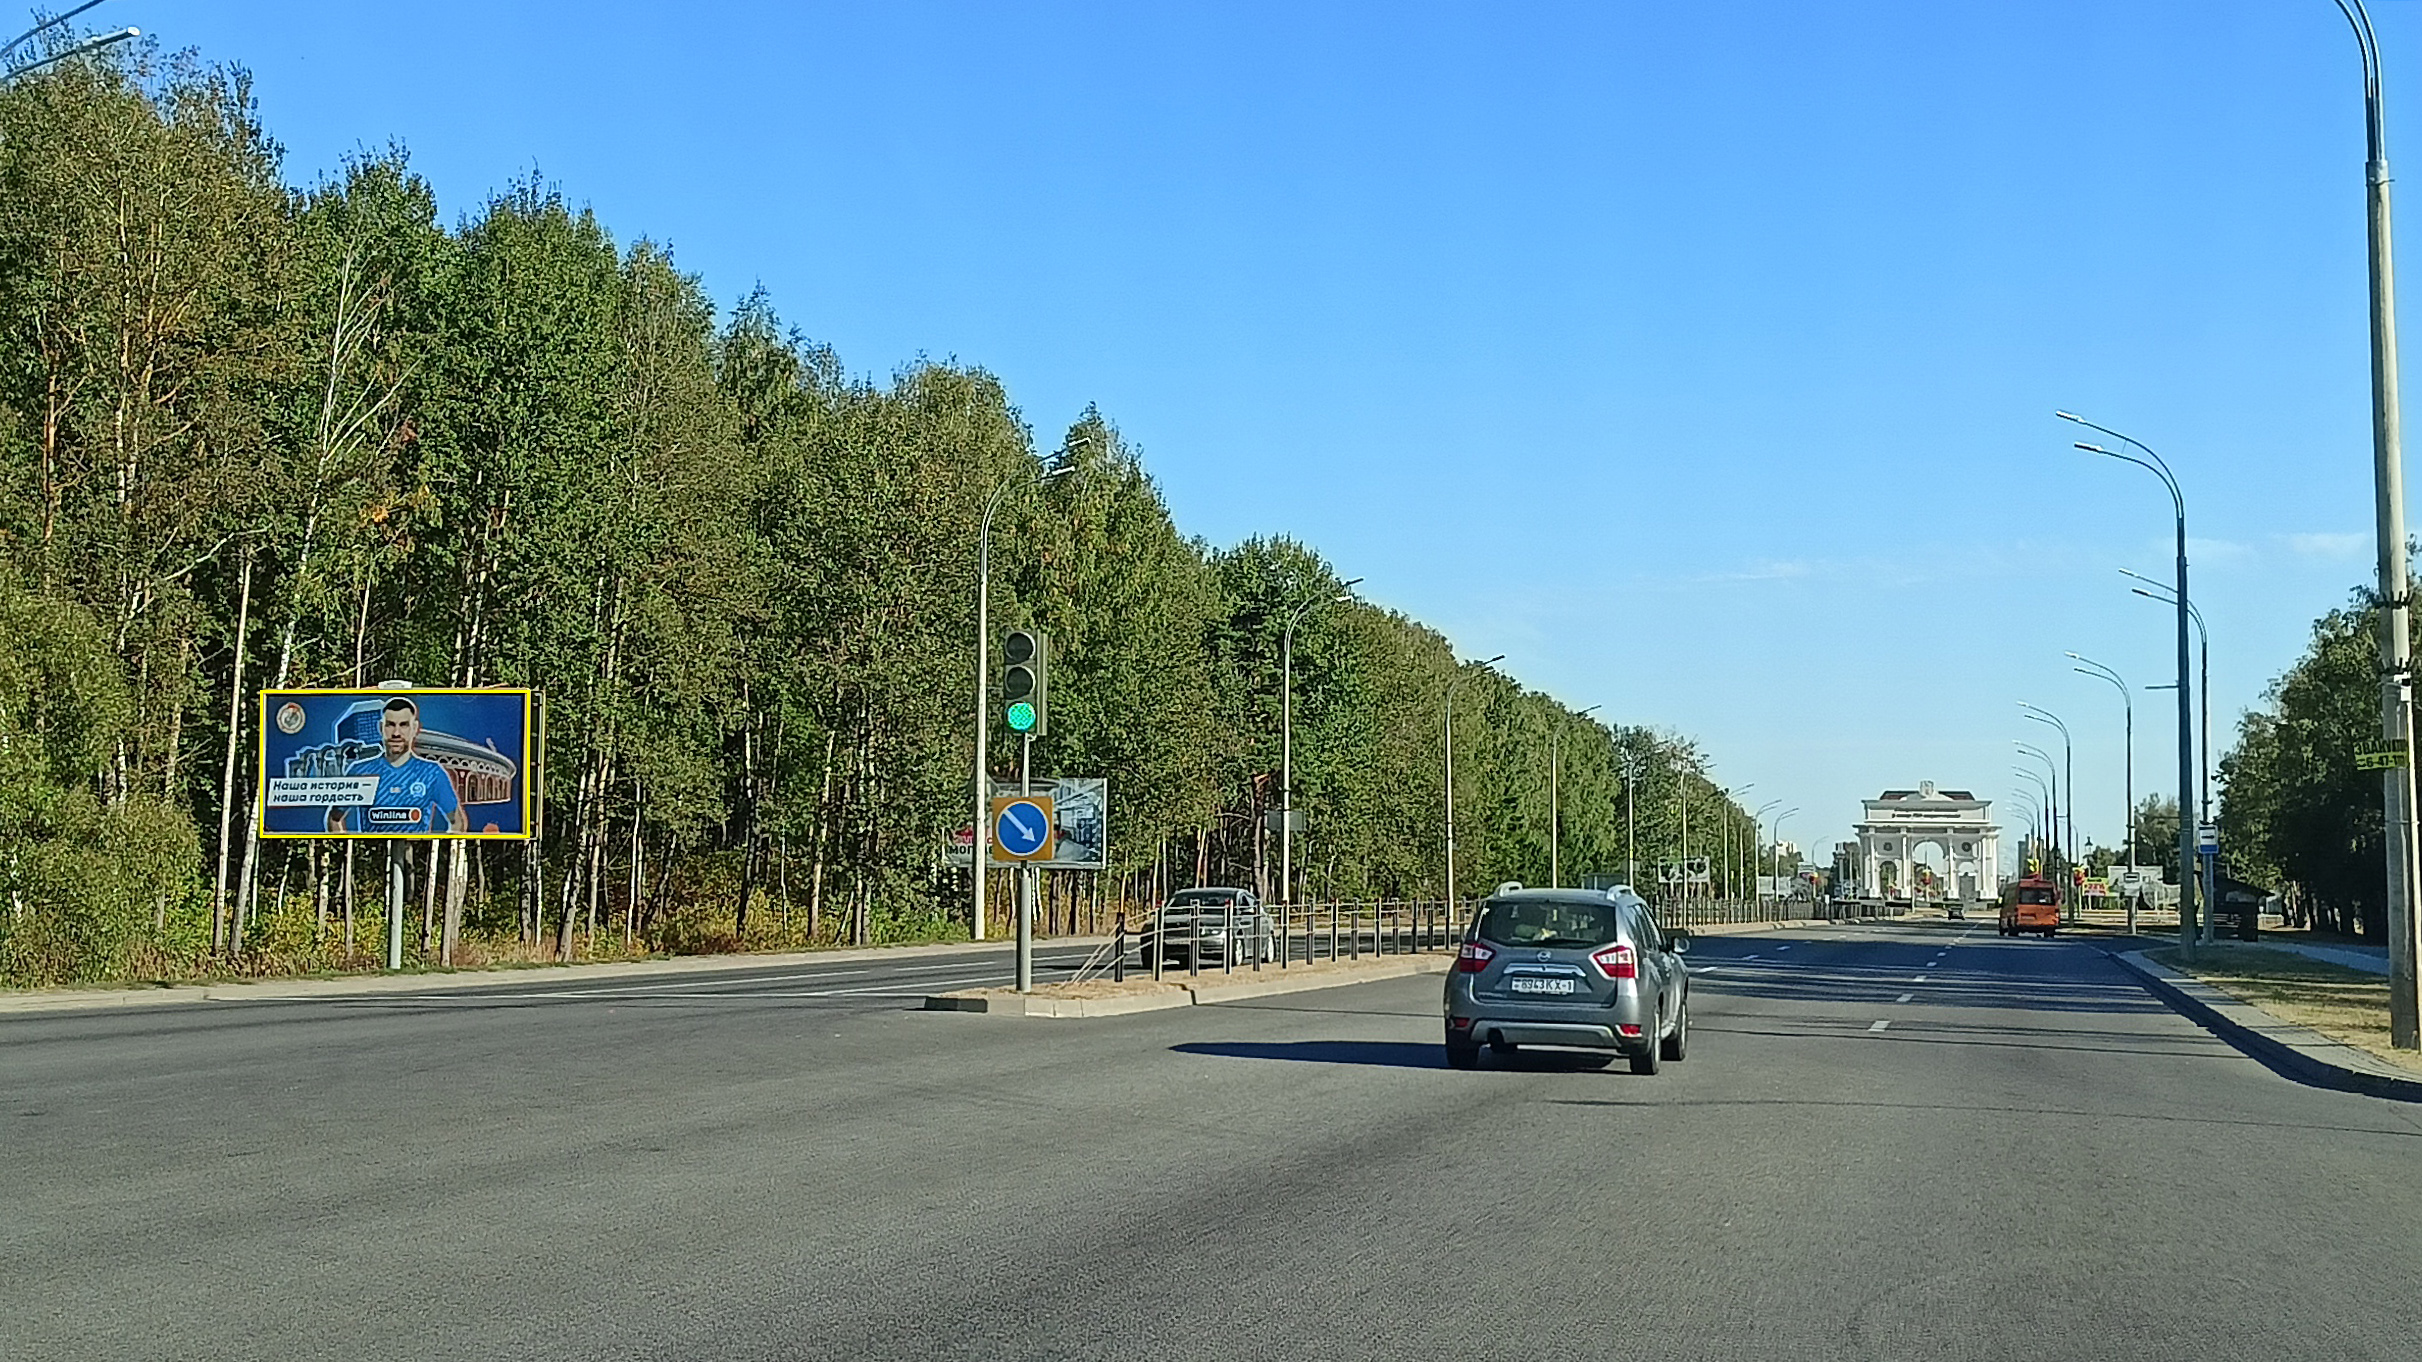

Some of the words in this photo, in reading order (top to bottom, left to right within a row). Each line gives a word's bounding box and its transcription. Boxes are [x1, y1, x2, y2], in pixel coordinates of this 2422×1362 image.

[273, 781, 308, 790] Наша
[310, 782, 359, 792] история
[273, 794, 307, 802] наша
[309, 794, 364, 803] гордость
[371, 810, 407, 819] Winline
